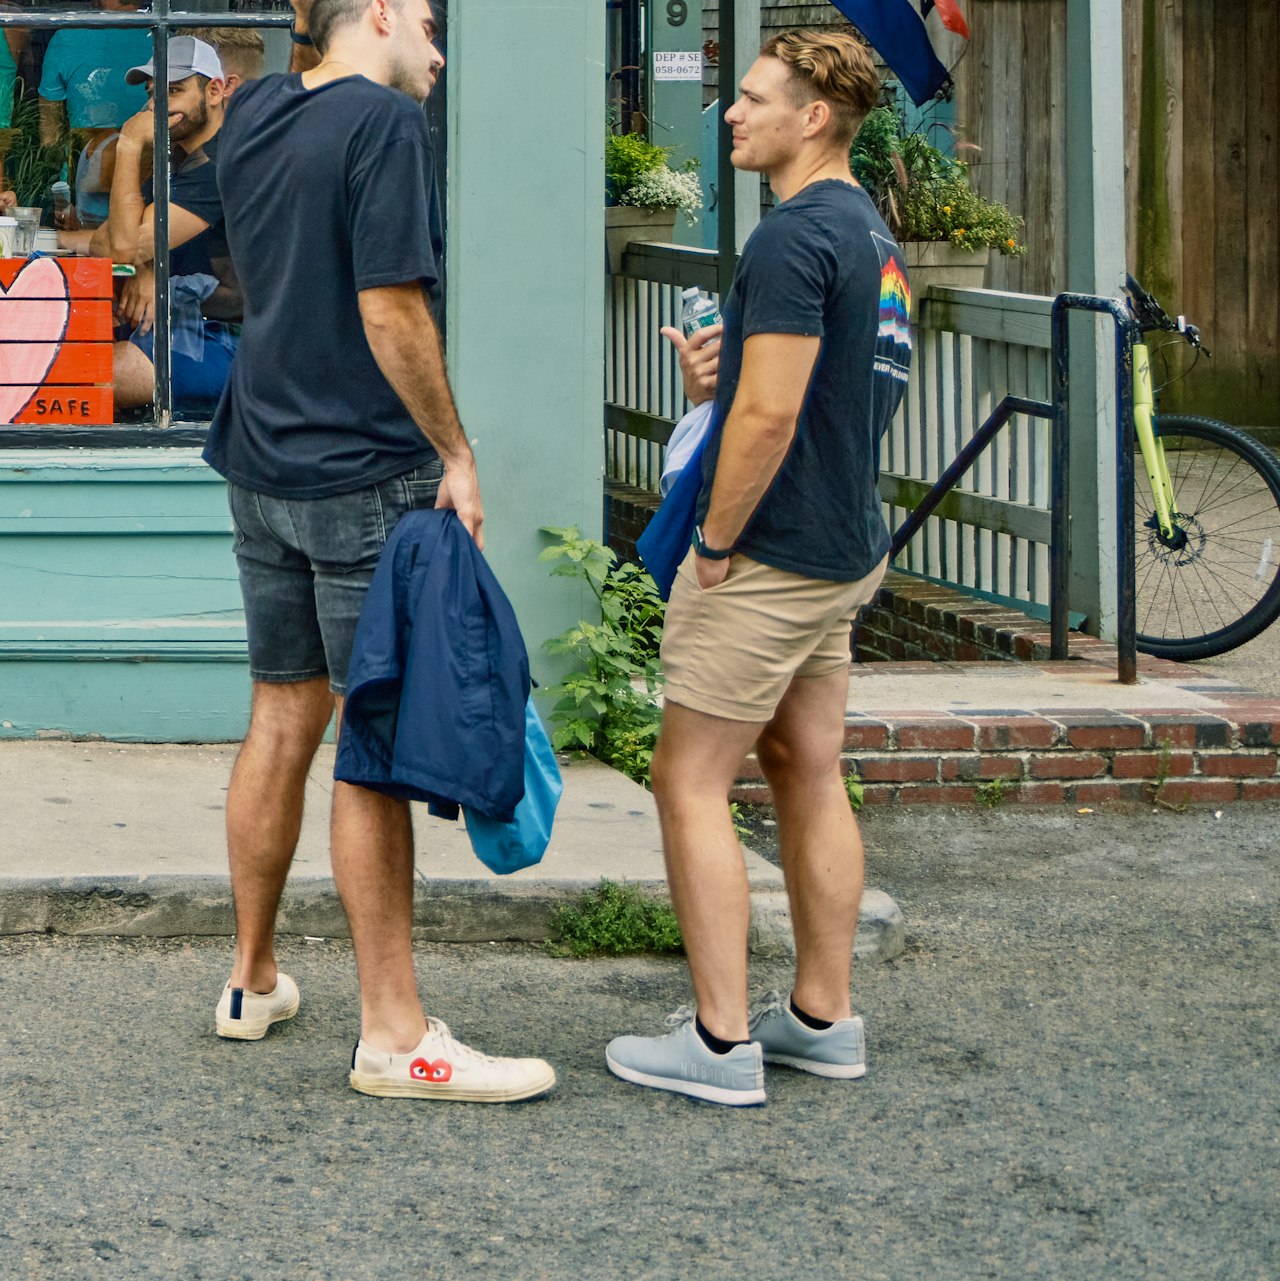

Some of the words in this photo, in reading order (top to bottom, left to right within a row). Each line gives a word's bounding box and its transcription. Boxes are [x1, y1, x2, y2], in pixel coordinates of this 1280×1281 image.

[655, 53, 676, 62] DEP
[688, 53, 700, 62] SE
[655, 65, 700, 74] 058-0672
[35, 399, 91, 418] SAFE
